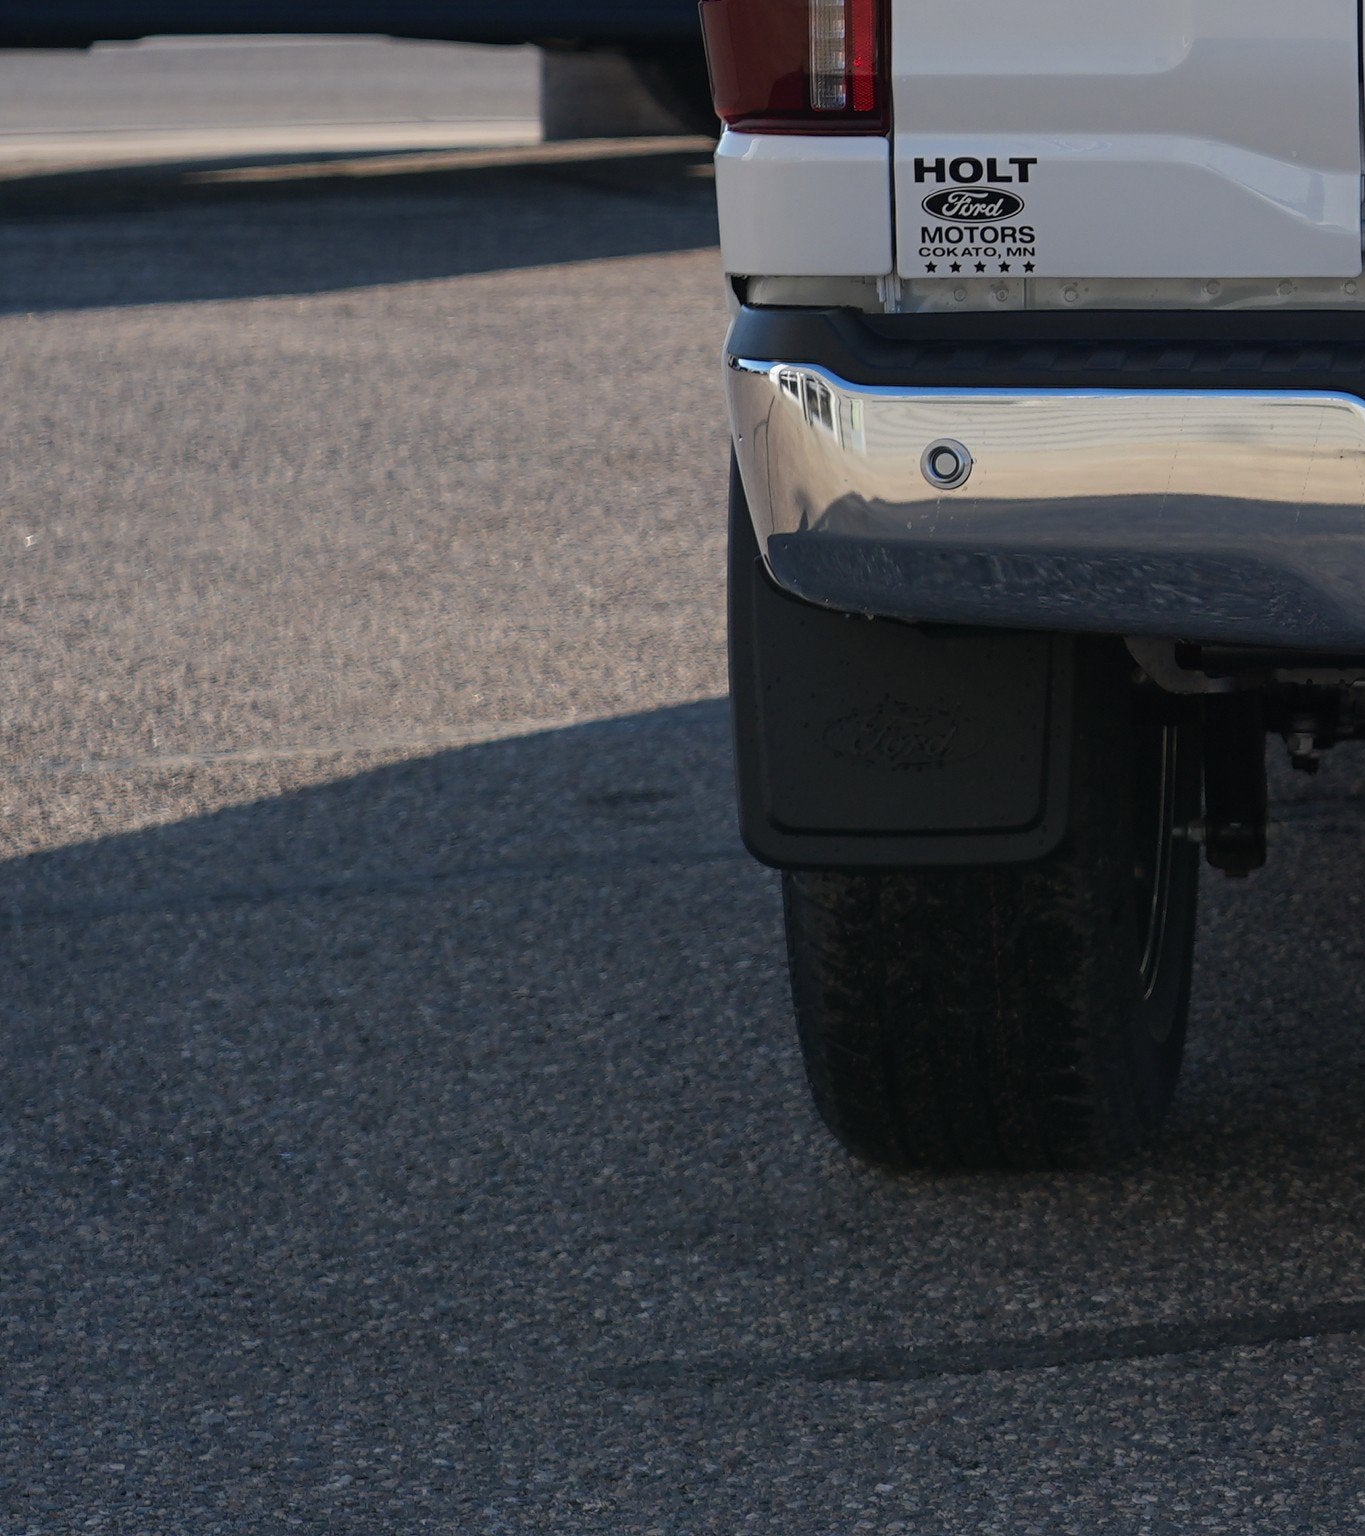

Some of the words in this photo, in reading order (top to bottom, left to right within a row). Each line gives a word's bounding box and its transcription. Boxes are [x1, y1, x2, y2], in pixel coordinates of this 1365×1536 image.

[914, 157, 1037, 183] HOLT
[941, 191, 1005, 217] Ford
[921, 226, 1036, 244] MOTORS
[918, 247, 1001, 259] COKATO,
[1006, 247, 1035, 257] MN
